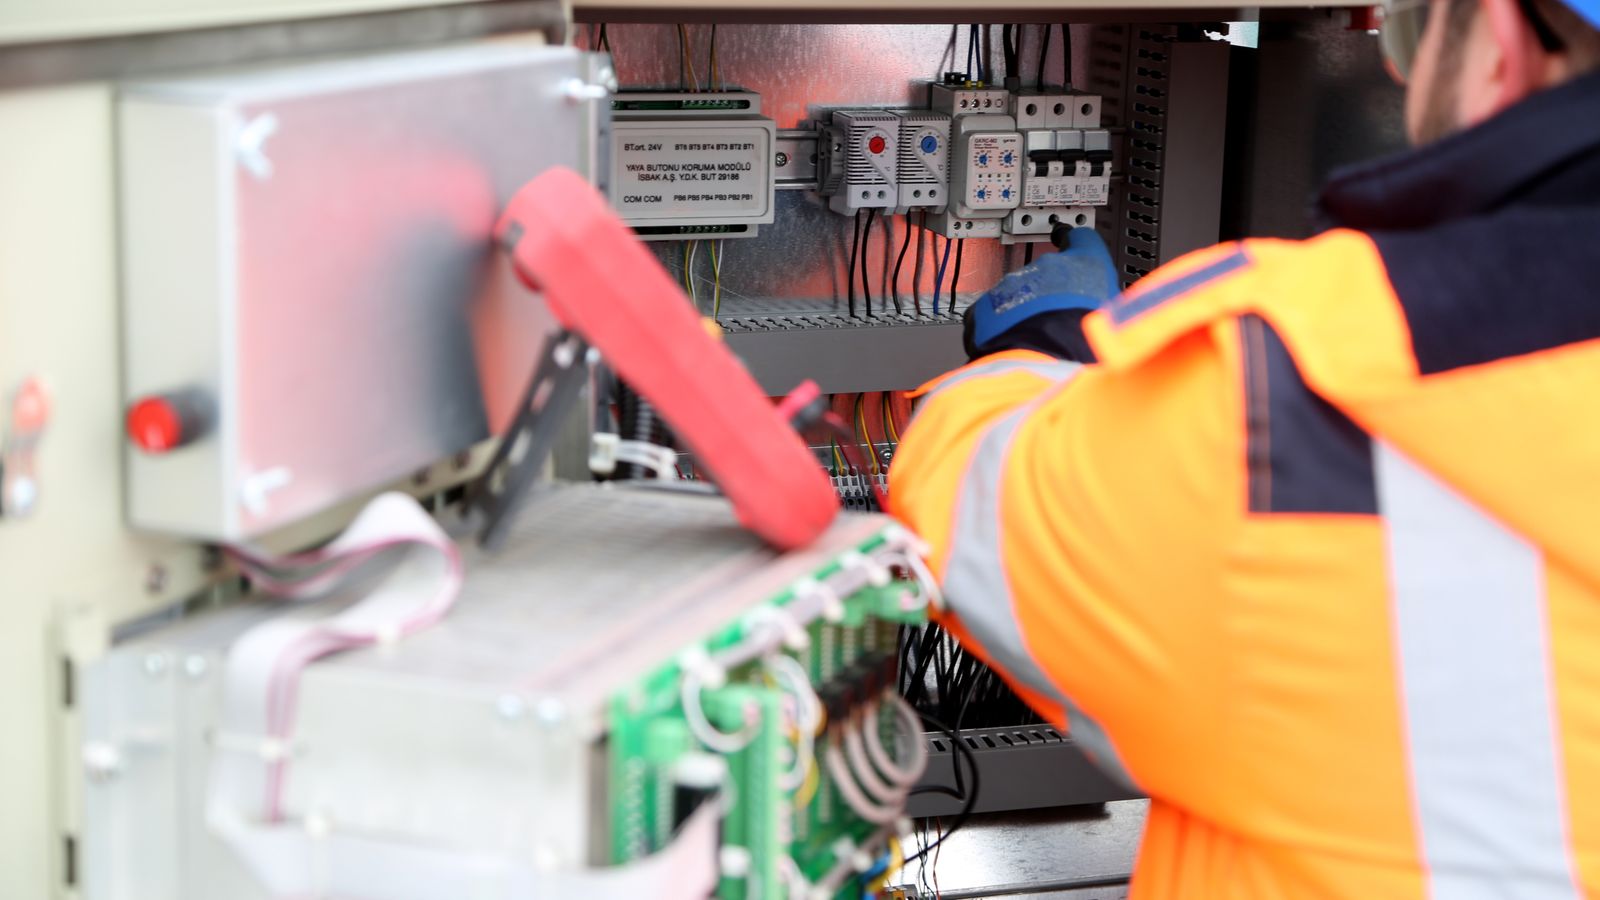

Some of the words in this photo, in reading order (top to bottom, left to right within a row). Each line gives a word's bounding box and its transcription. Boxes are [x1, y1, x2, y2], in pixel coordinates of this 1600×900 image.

[648, 143, 663, 151] 24V
[646, 163, 680, 171] BUTONU
[681, 163, 716, 171] KORUMA
[717, 162, 751, 171] MODÜLÜ
[638, 172, 661, 181] İSBAK
[662, 173, 677, 183] A.Ş.
[679, 173, 699, 181] Y.D.K.
[701, 173, 717, 181] BUT
[623, 195, 642, 203] COM
[643, 195, 662, 203] COM
